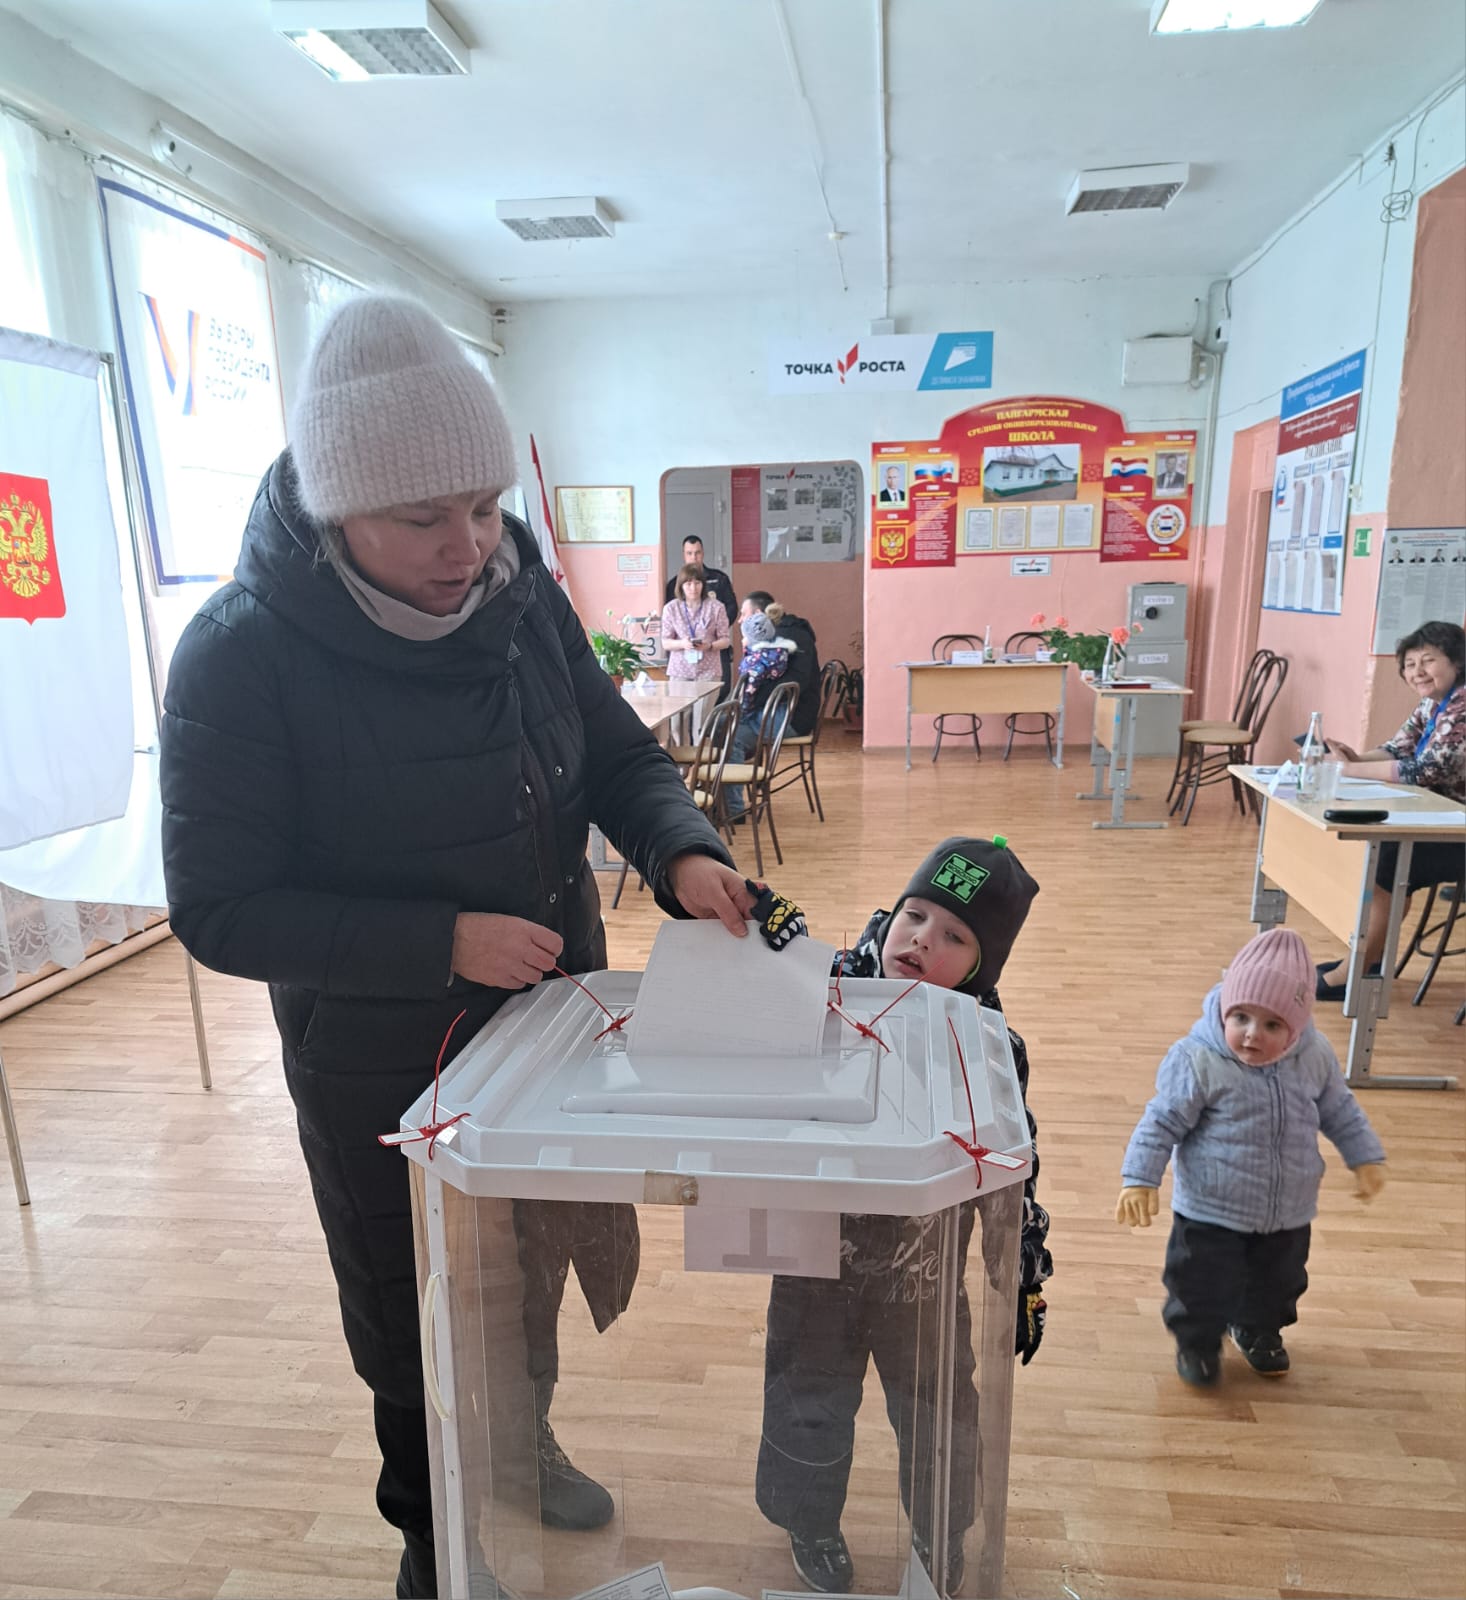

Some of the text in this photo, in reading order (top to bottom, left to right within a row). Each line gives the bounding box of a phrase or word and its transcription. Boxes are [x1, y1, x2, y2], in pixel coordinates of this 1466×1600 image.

[784, 361, 906, 375] ТОЧКА РОСТА
[1008, 431, 1055, 442] ШКОЛА
[646, 637, 656, 656] 3
